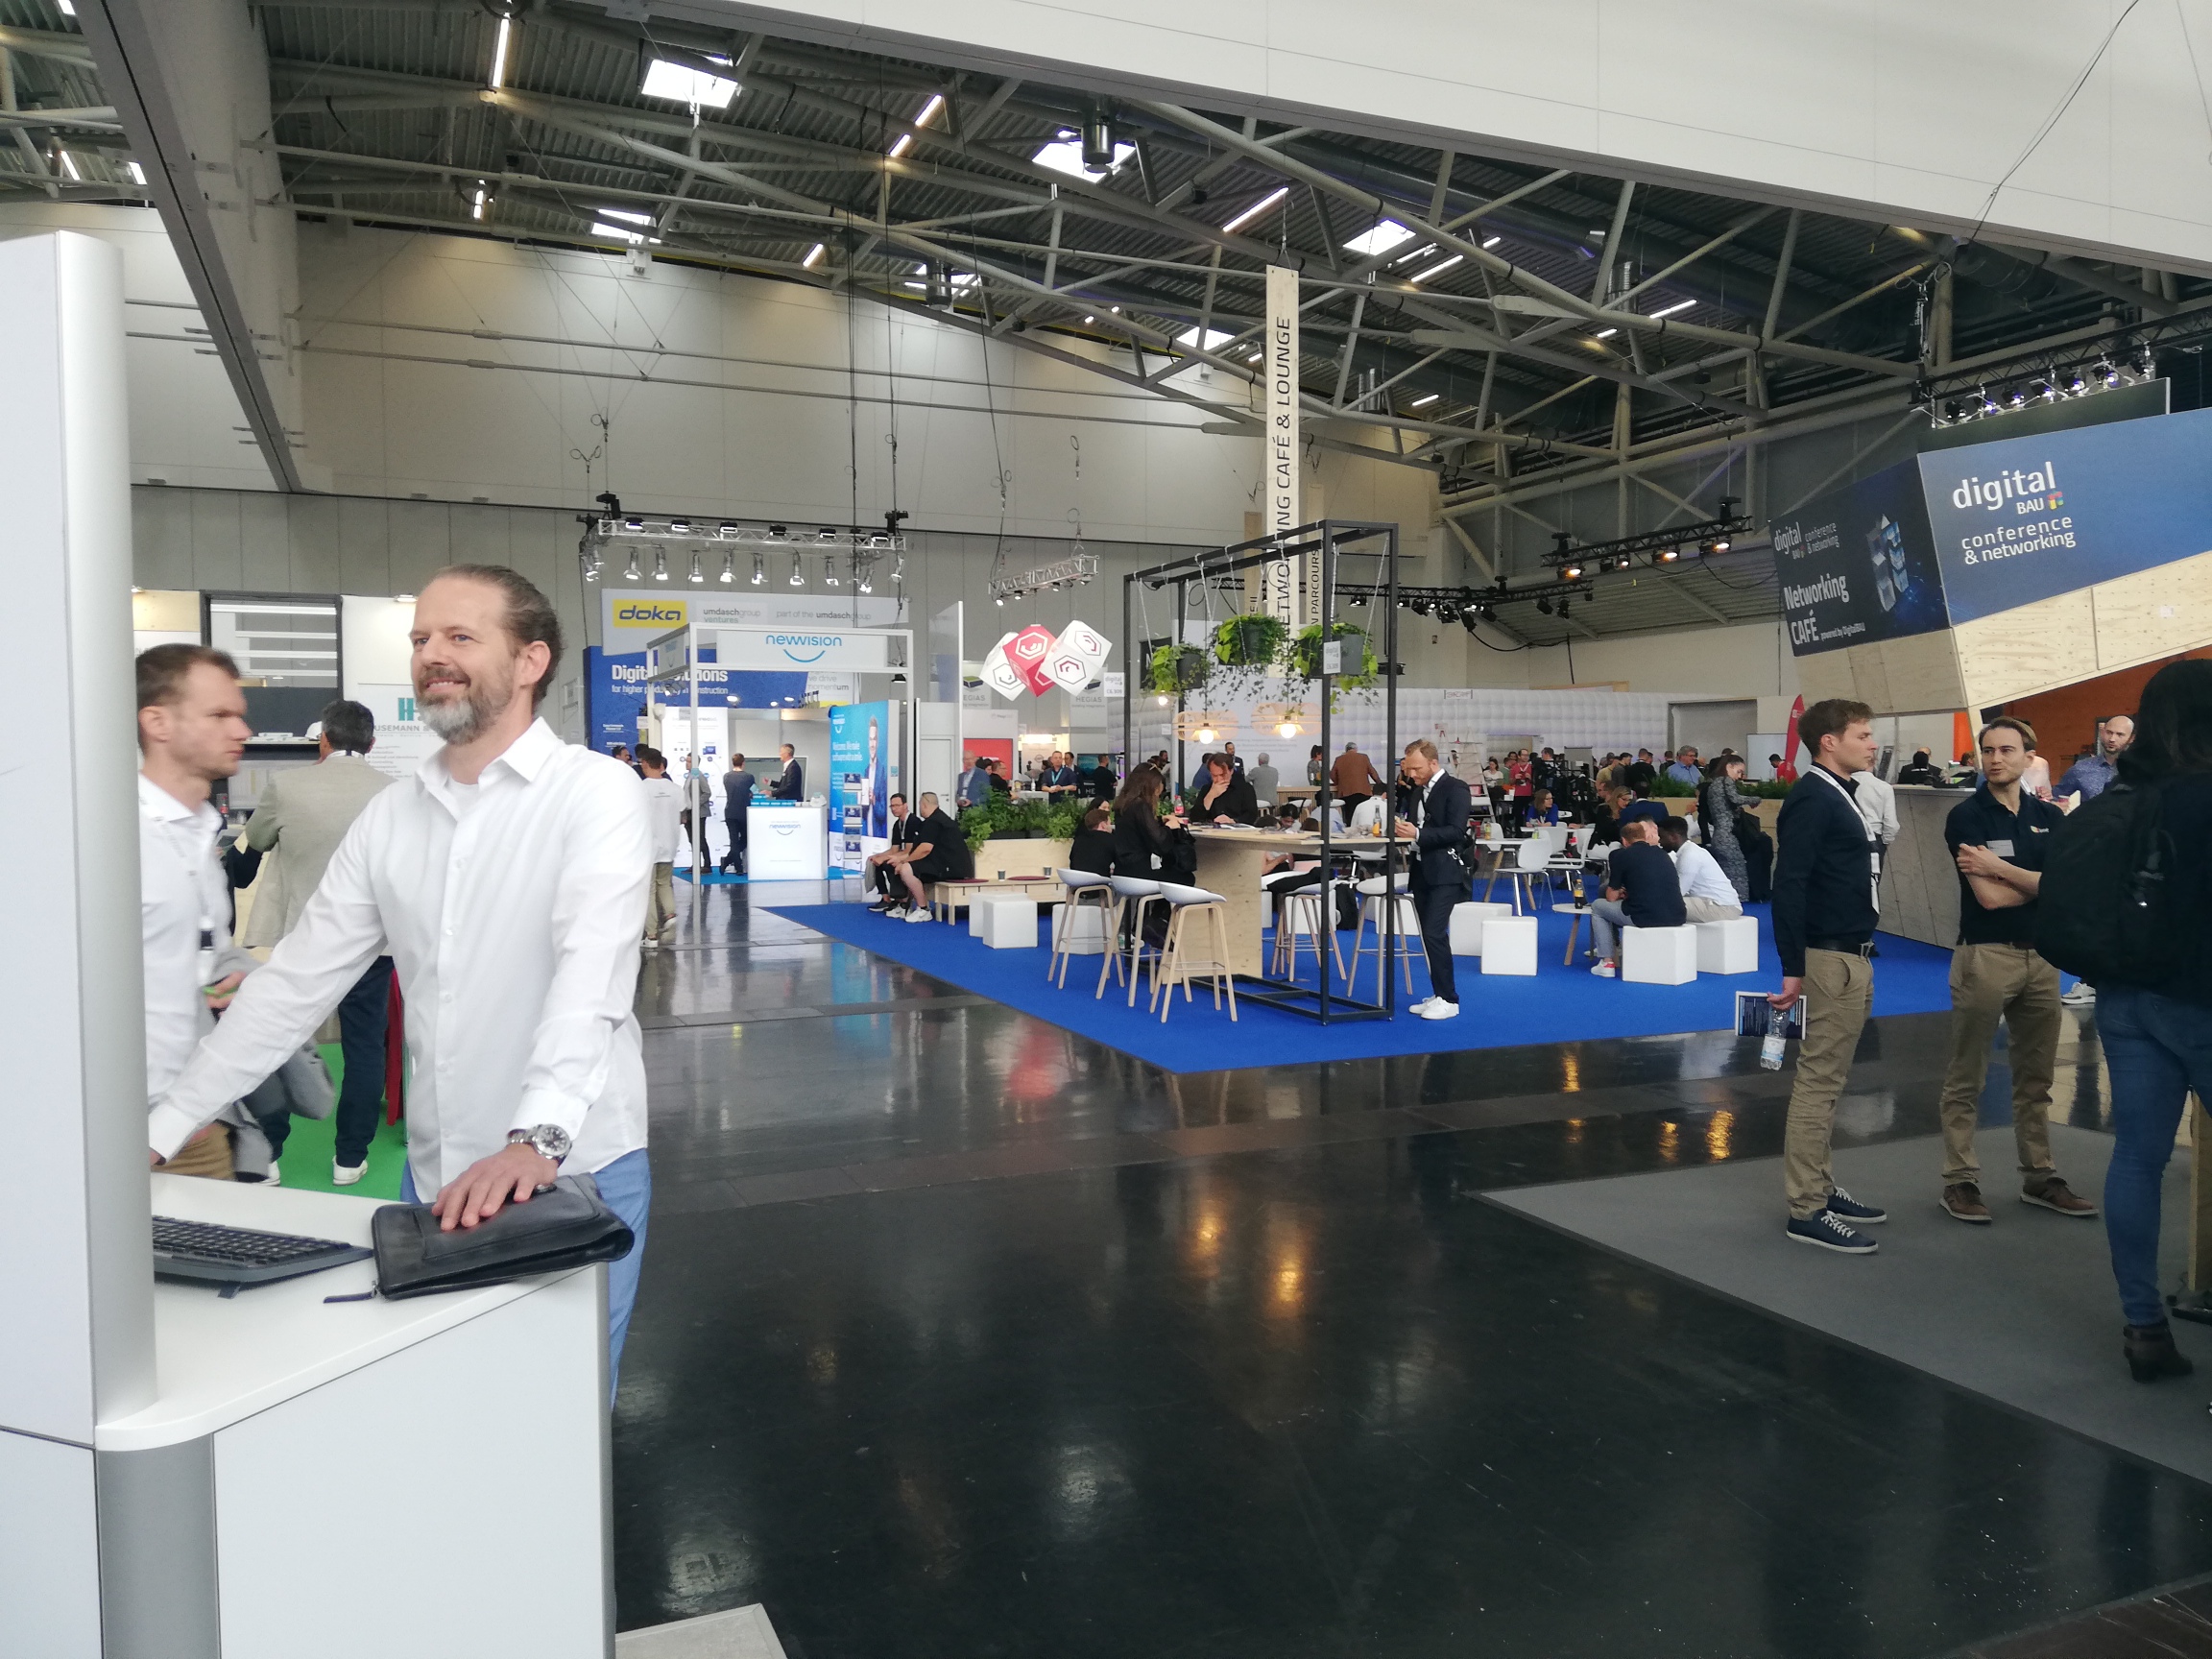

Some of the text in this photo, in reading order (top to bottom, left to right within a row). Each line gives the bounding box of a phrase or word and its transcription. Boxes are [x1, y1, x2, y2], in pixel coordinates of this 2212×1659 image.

[1276, 316, 1291, 406] LOUNGE
[1277, 413, 1290, 429] &
[1272, 435, 1291, 491] CAFÉ
[1953, 461, 2056, 511] digital
[2016, 497, 2044, 515] BAU
[1774, 521, 1802, 555] digital
[1805, 522, 1837, 542] conference
[1812, 535, 1840, 552] networking
[1961, 517, 2073, 550] conference
[1964, 532, 2077, 565] & networking
[1783, 572, 1850, 610] Networking
[618, 605, 682, 621] doka
[703, 608, 760, 619] umdaschgroup
[1791, 609, 1819, 645] CAFÉ
[612, 664, 658, 683] Digitl
